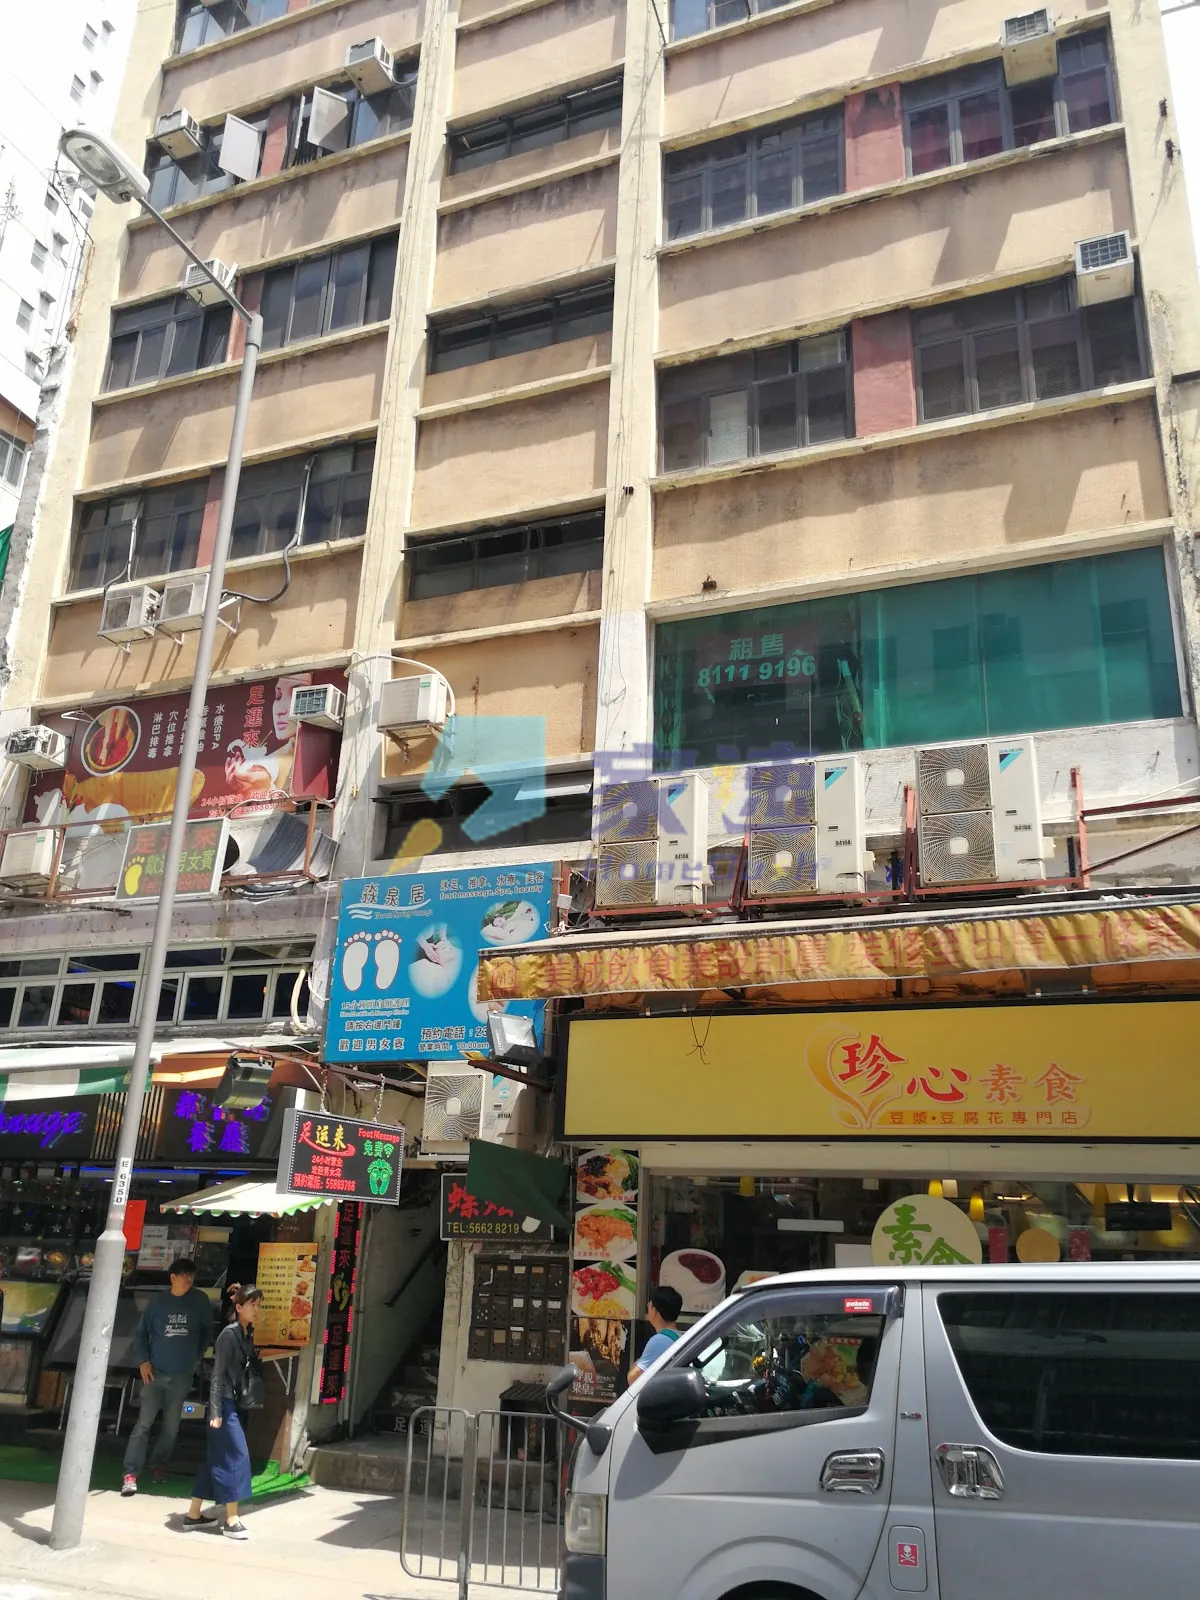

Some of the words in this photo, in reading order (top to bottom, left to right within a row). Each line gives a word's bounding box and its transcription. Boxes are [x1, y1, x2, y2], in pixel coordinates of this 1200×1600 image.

[729, 633, 785, 661] 租售
[697, 664, 749, 687] 8111
[759, 654, 816, 681] 9196
[339, 1037, 405, 1051] 歡迎男女賓
[115, 1173, 128, 1204] 6350
[494, 1223, 520, 1234] 8219
